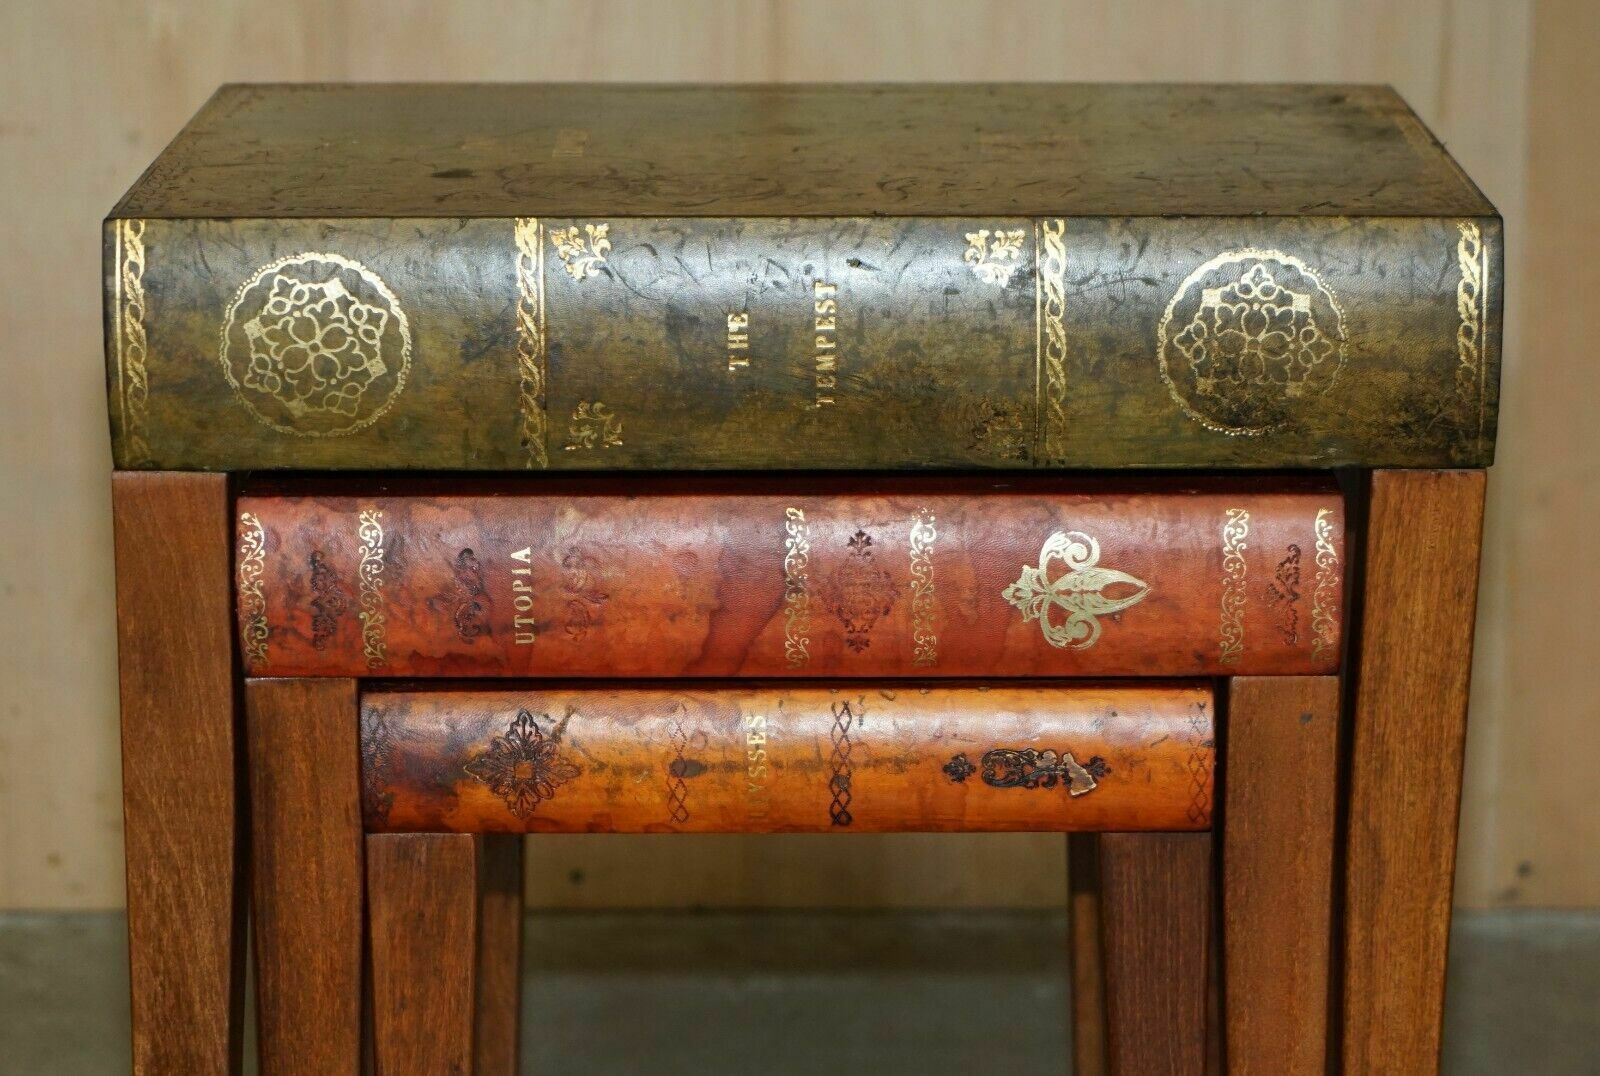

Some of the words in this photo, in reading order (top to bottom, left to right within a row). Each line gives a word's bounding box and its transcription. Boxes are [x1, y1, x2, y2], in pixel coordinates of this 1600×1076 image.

[728, 313, 750, 371] THE
[815, 281, 836, 408] TEMPEST
[510, 546, 535, 645] UTOPIA
[746, 715, 768, 820] YSSES
